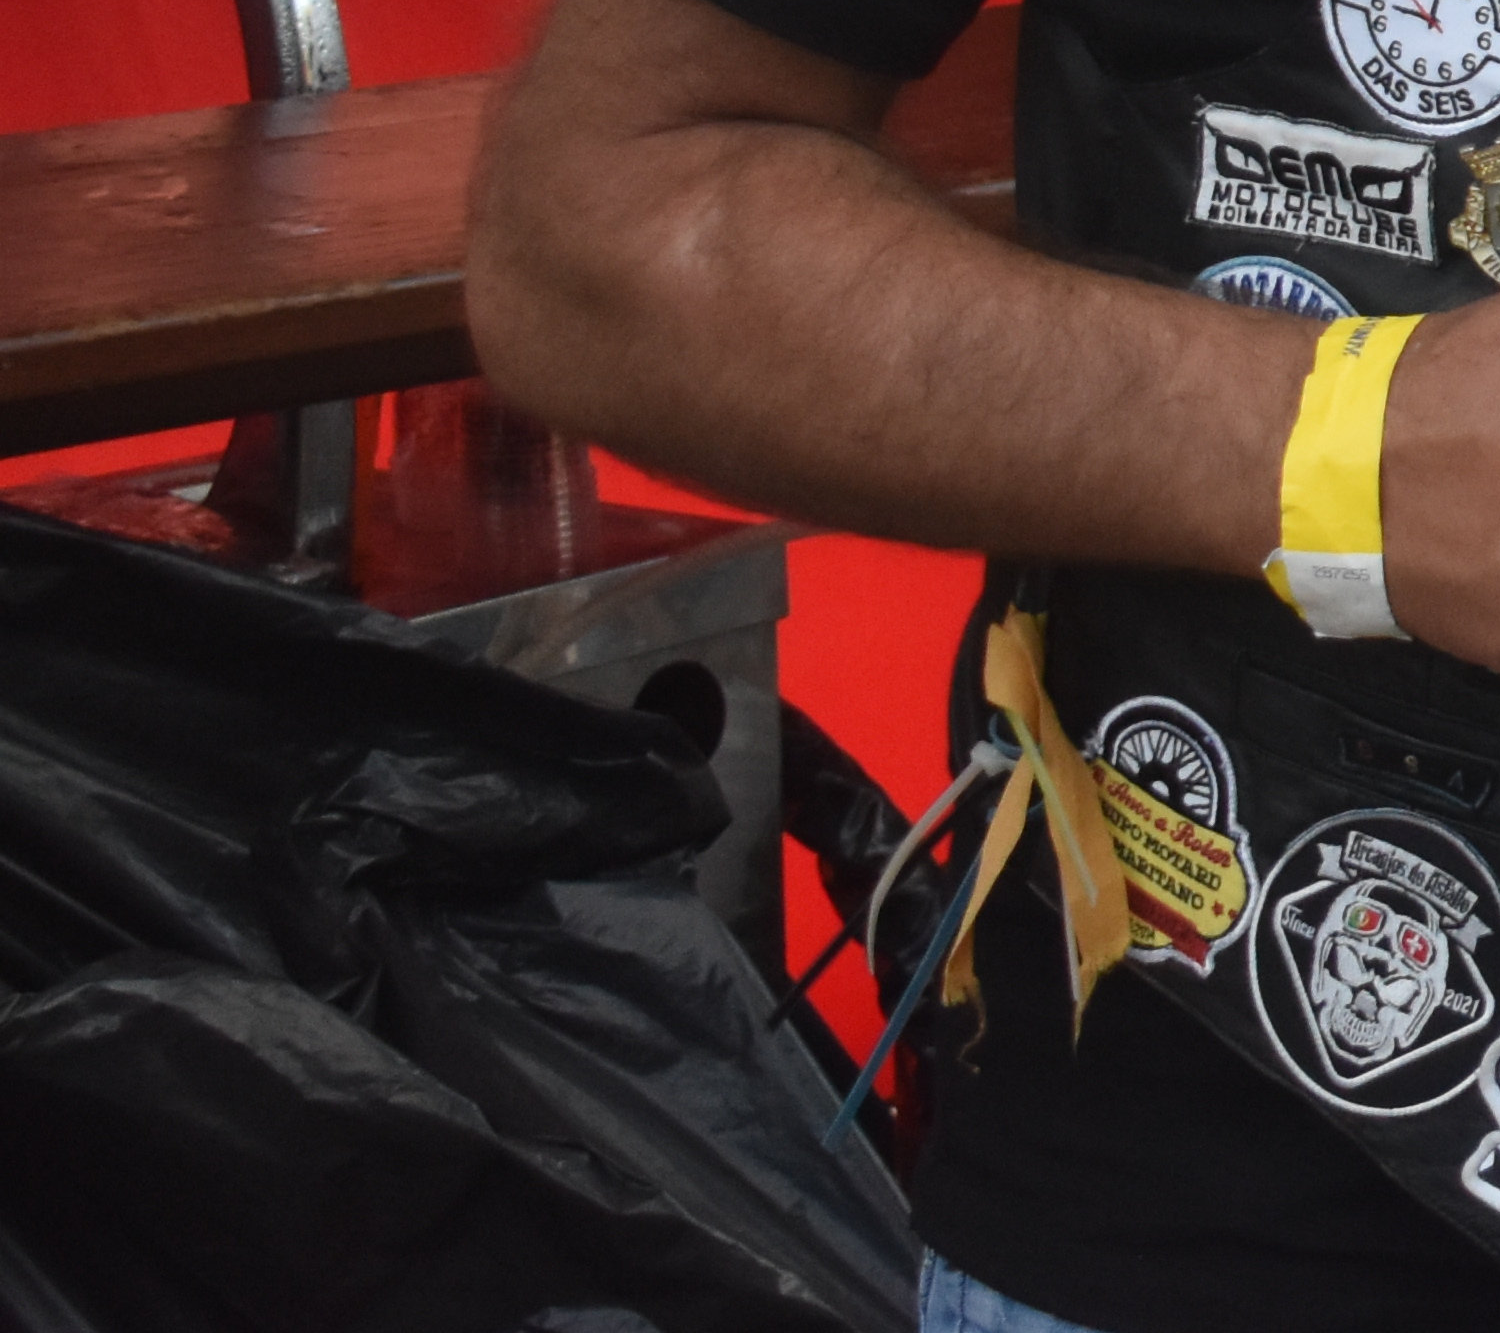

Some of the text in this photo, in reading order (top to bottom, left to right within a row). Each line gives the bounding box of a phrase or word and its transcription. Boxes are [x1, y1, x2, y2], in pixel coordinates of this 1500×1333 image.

[1374, 15, 1388, 33] 6
[1476, 6, 1490, 24] 6
[1388, 41, 1402, 60] 6
[1478, 32, 1491, 50] 6
[1414, 58, 1427, 76] 6
[1438, 62, 1452, 80] 6
[1462, 54, 1476, 72] 6
[1361, 57, 1476, 116] DAS SEIS
[1211, 180, 1419, 239] MOTOCLUBE
[1323, 220, 1350, 239] DA
[1357, 227, 1424, 256] BEIRA
[1143, 835, 1222, 891] MOTARD
[1349, 834, 1472, 914] Arcanjos do Asfalto
[1280, 904, 1314, 941] Since
[1442, 988, 1481, 1019] 2021
